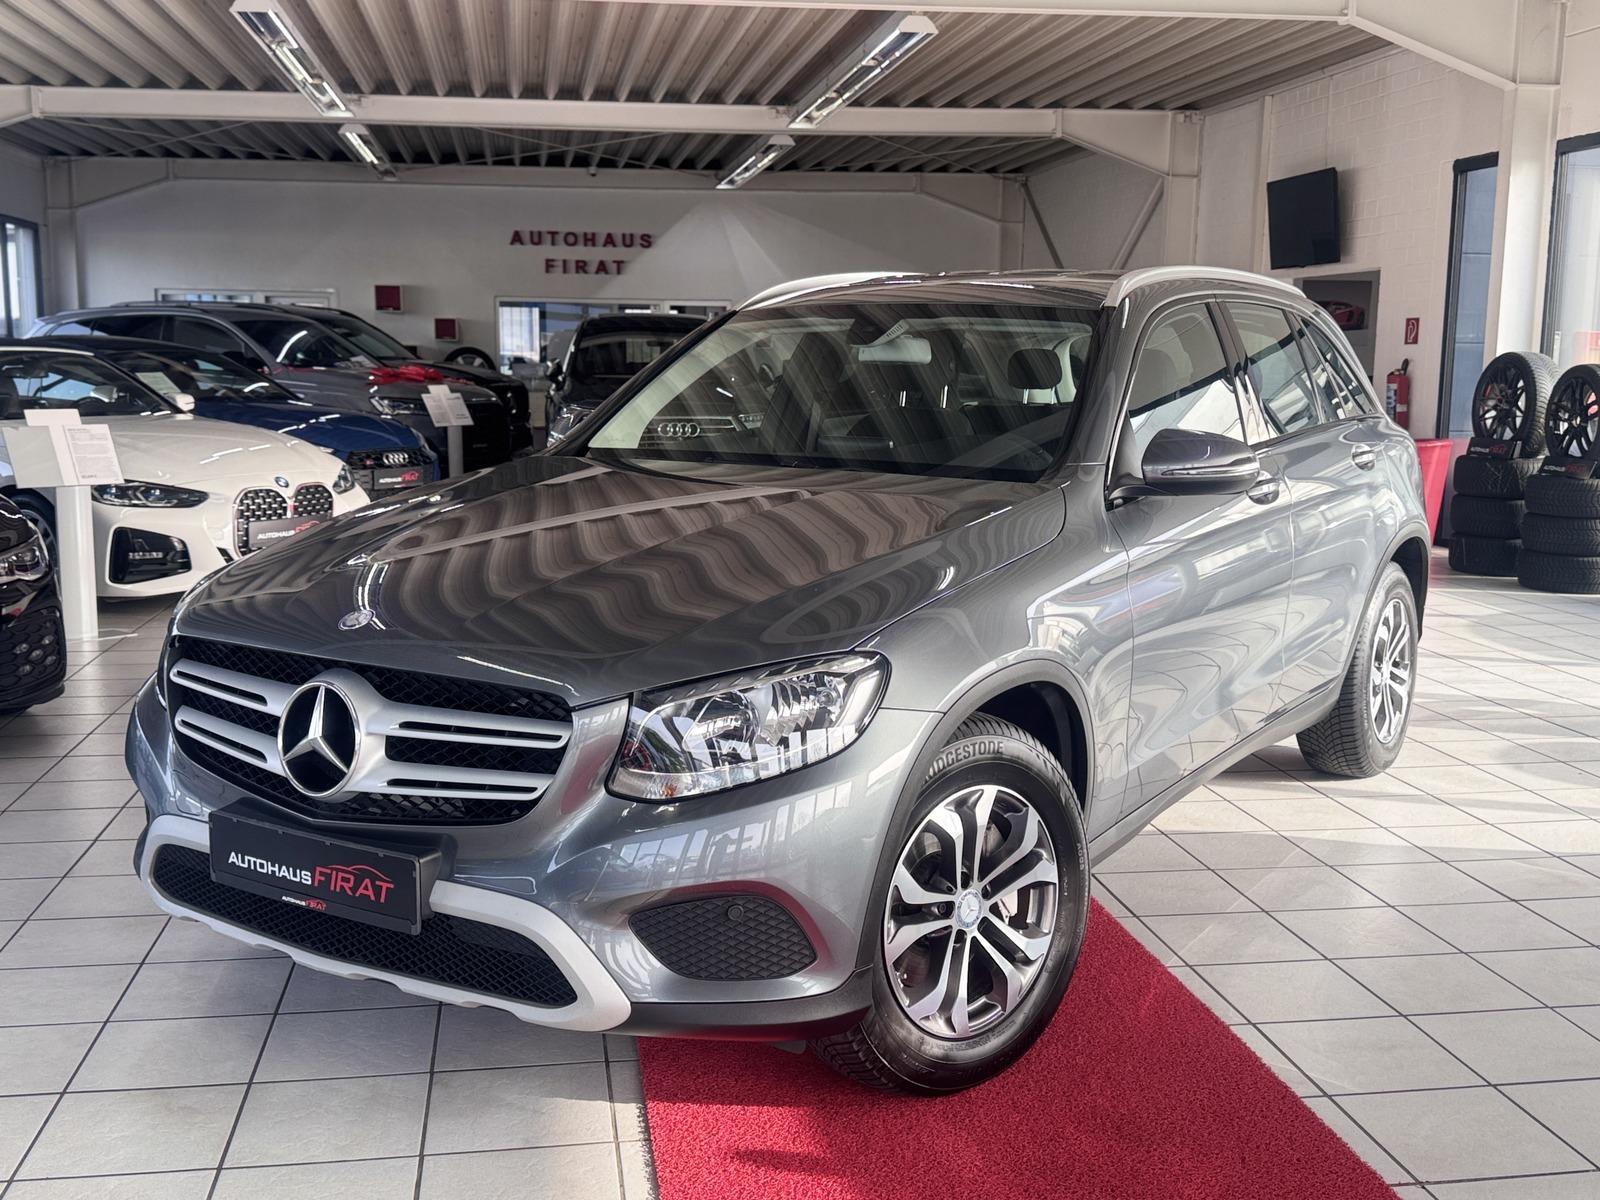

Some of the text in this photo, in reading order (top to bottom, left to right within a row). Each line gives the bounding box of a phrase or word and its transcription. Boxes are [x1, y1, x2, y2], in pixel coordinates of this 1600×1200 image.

[509, 230, 653, 249] AUTOHAUS
[544, 258, 626, 275] FIRAT
[228, 851, 395, 903] AUTOHAUS FIRAT
